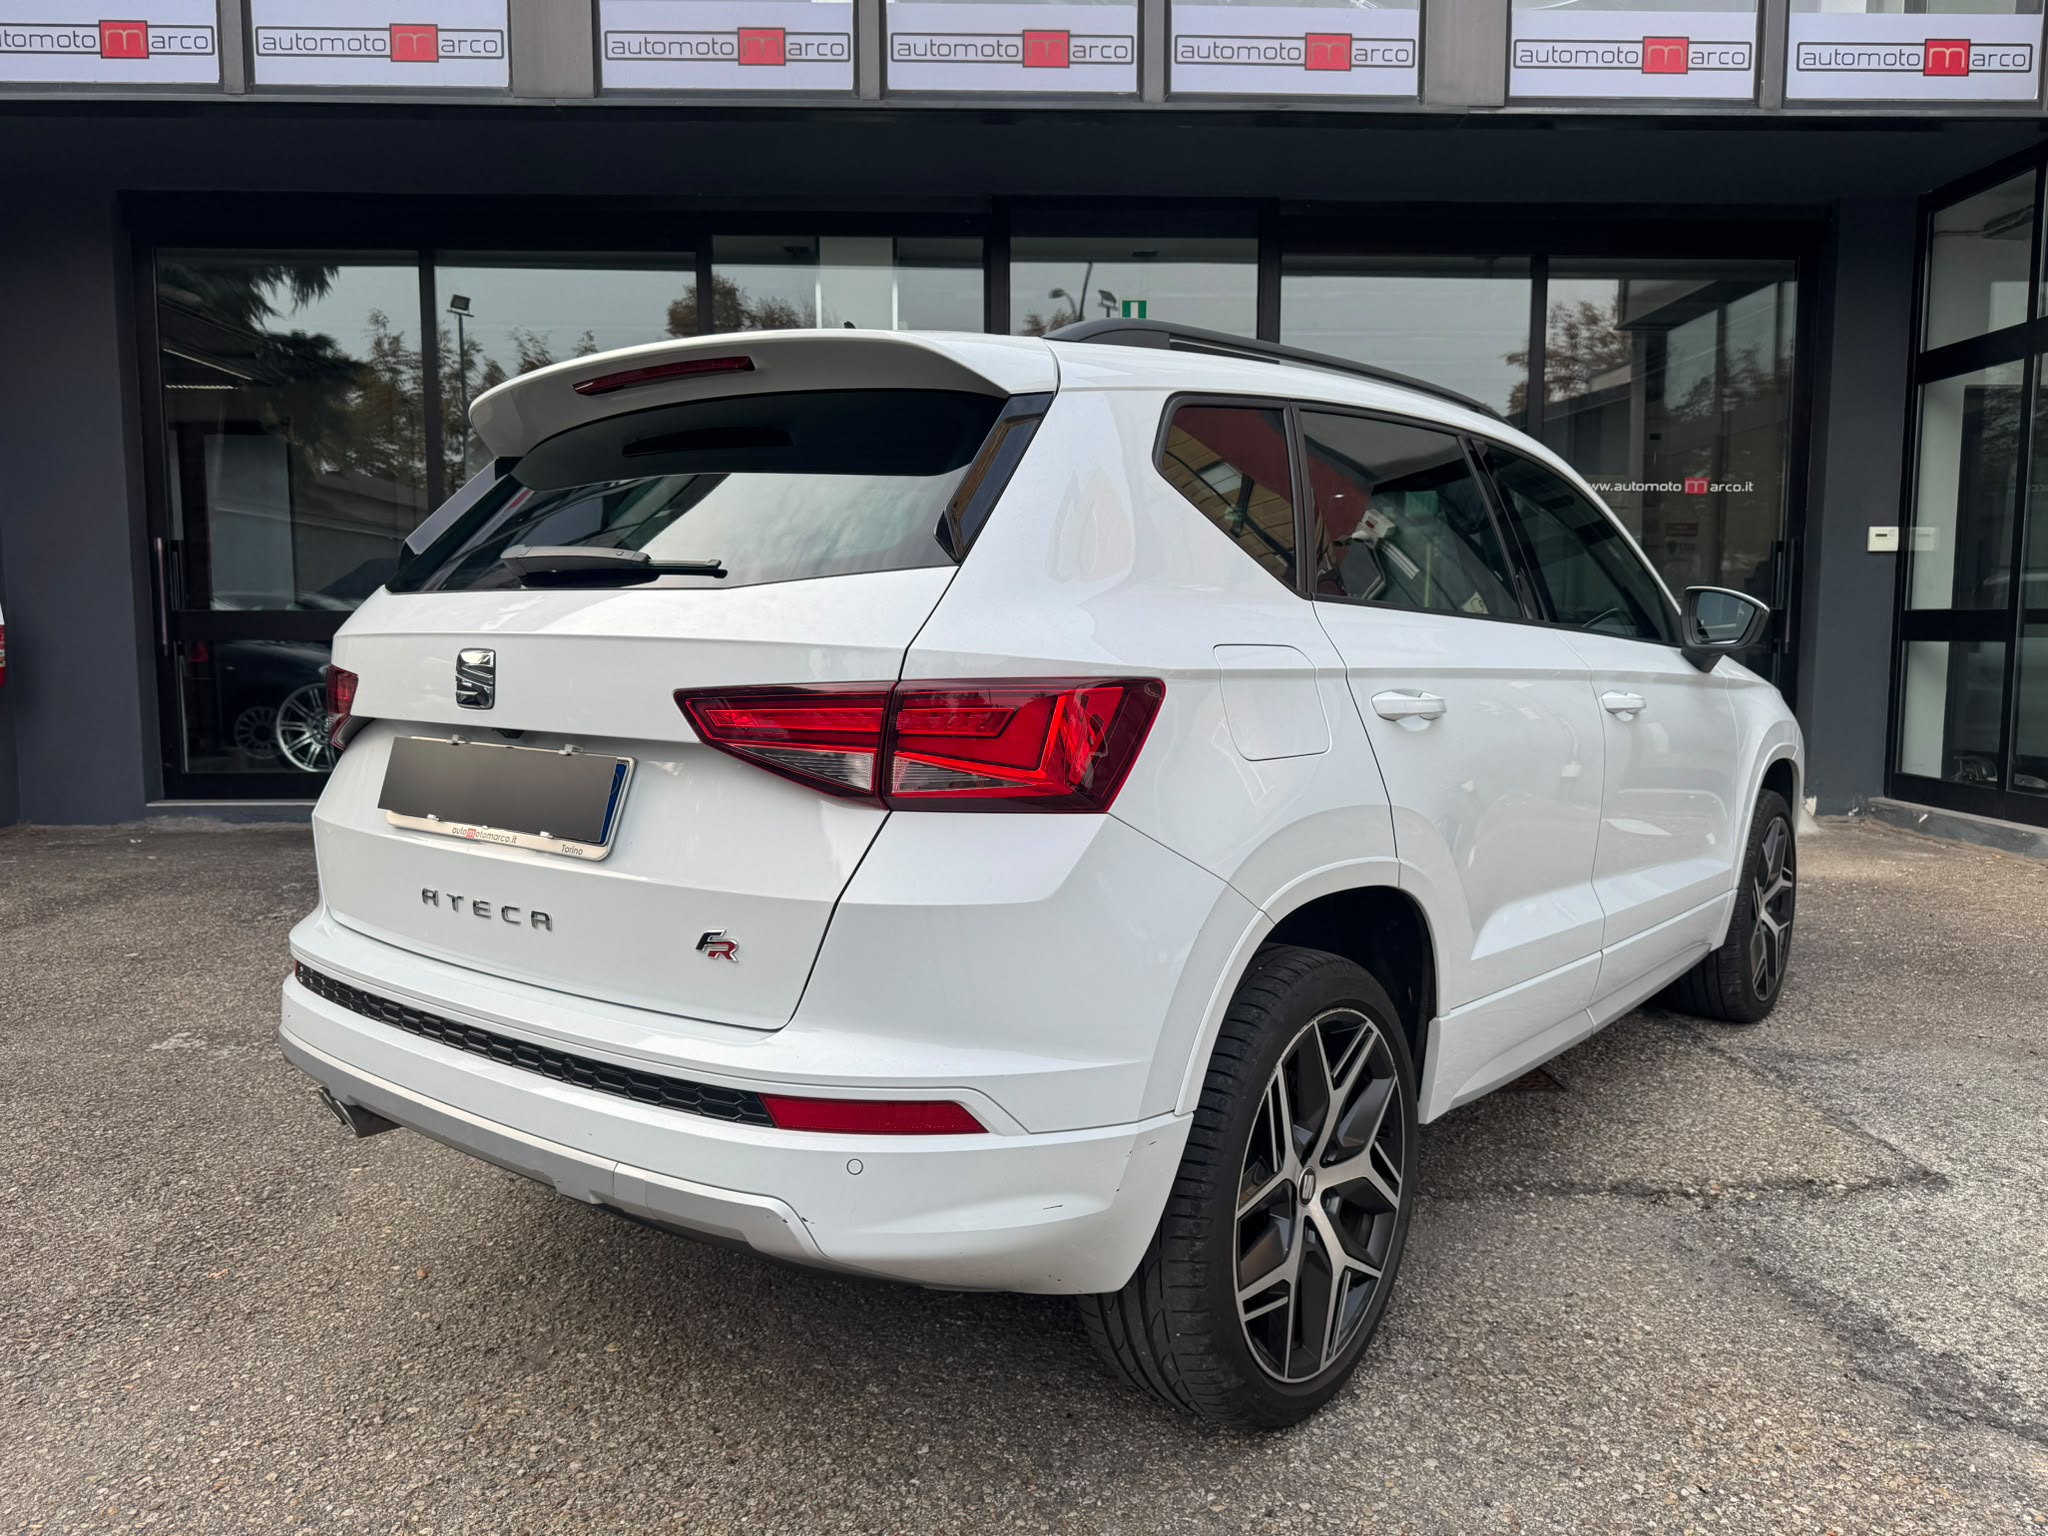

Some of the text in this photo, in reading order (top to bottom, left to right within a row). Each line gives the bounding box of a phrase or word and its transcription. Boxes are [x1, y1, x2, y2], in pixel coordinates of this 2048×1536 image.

[0, 29, 208, 50] tomotomarco
[561, 844, 584, 856] Torino
[421, 888, 553, 931] ATECA
[695, 928, 740, 963] FR
